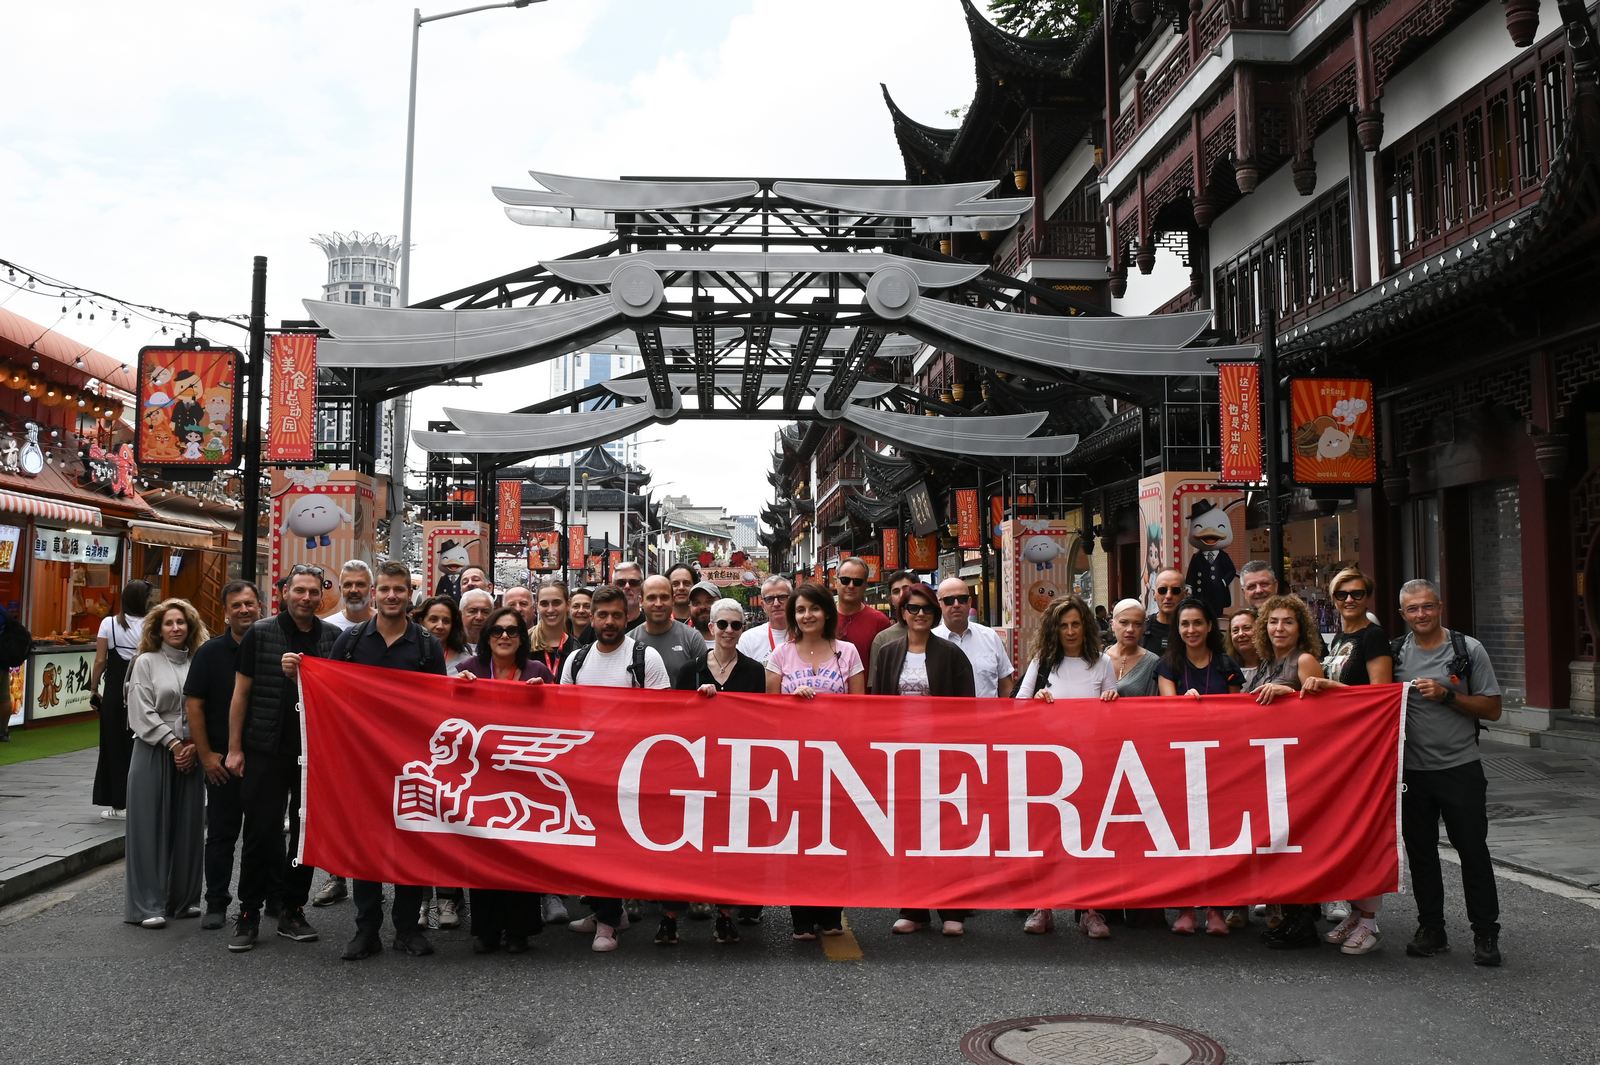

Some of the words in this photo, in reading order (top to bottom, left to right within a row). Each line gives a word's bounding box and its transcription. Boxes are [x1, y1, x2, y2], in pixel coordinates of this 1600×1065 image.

[1228, 403, 1241, 455] 也是出发
[783, 679, 845, 694] YORSELF
[617, 734, 1303, 859] GENERALI
